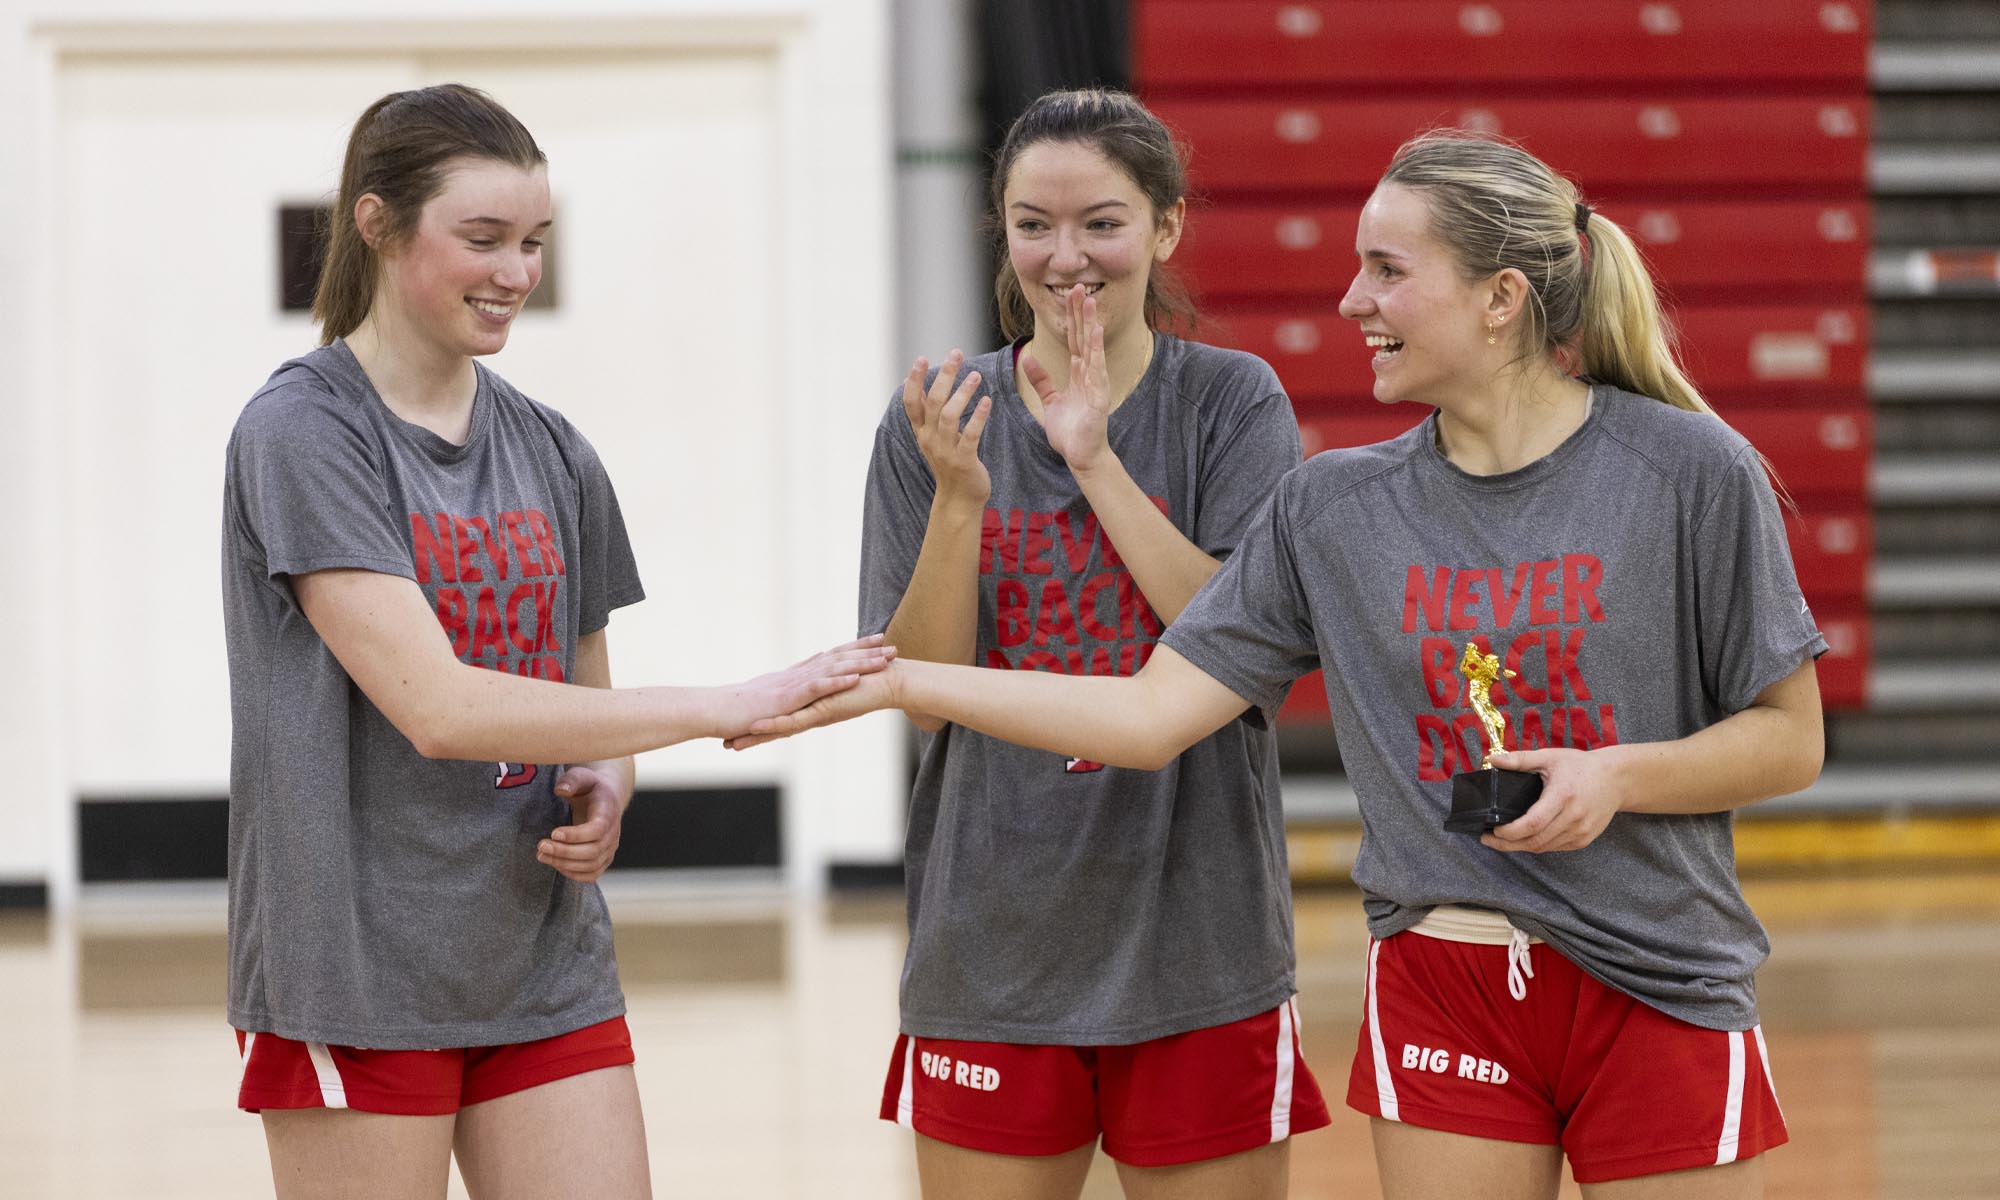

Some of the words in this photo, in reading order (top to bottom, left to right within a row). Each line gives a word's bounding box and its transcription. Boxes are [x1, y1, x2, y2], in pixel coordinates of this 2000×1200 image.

[410, 509, 565, 583] NEVER
[979, 497, 1168, 575] NEV
[437, 581, 560, 658] BACK
[996, 572, 1159, 647] BACK
[1402, 553, 1606, 633] NEVER
[1420, 628, 1592, 709] BACK
[921, 1051, 951, 1081] BIG
[955, 1060, 1000, 1092] RED
[1402, 1043, 1450, 1074] BIG
[1457, 1053, 1509, 1085] RED
